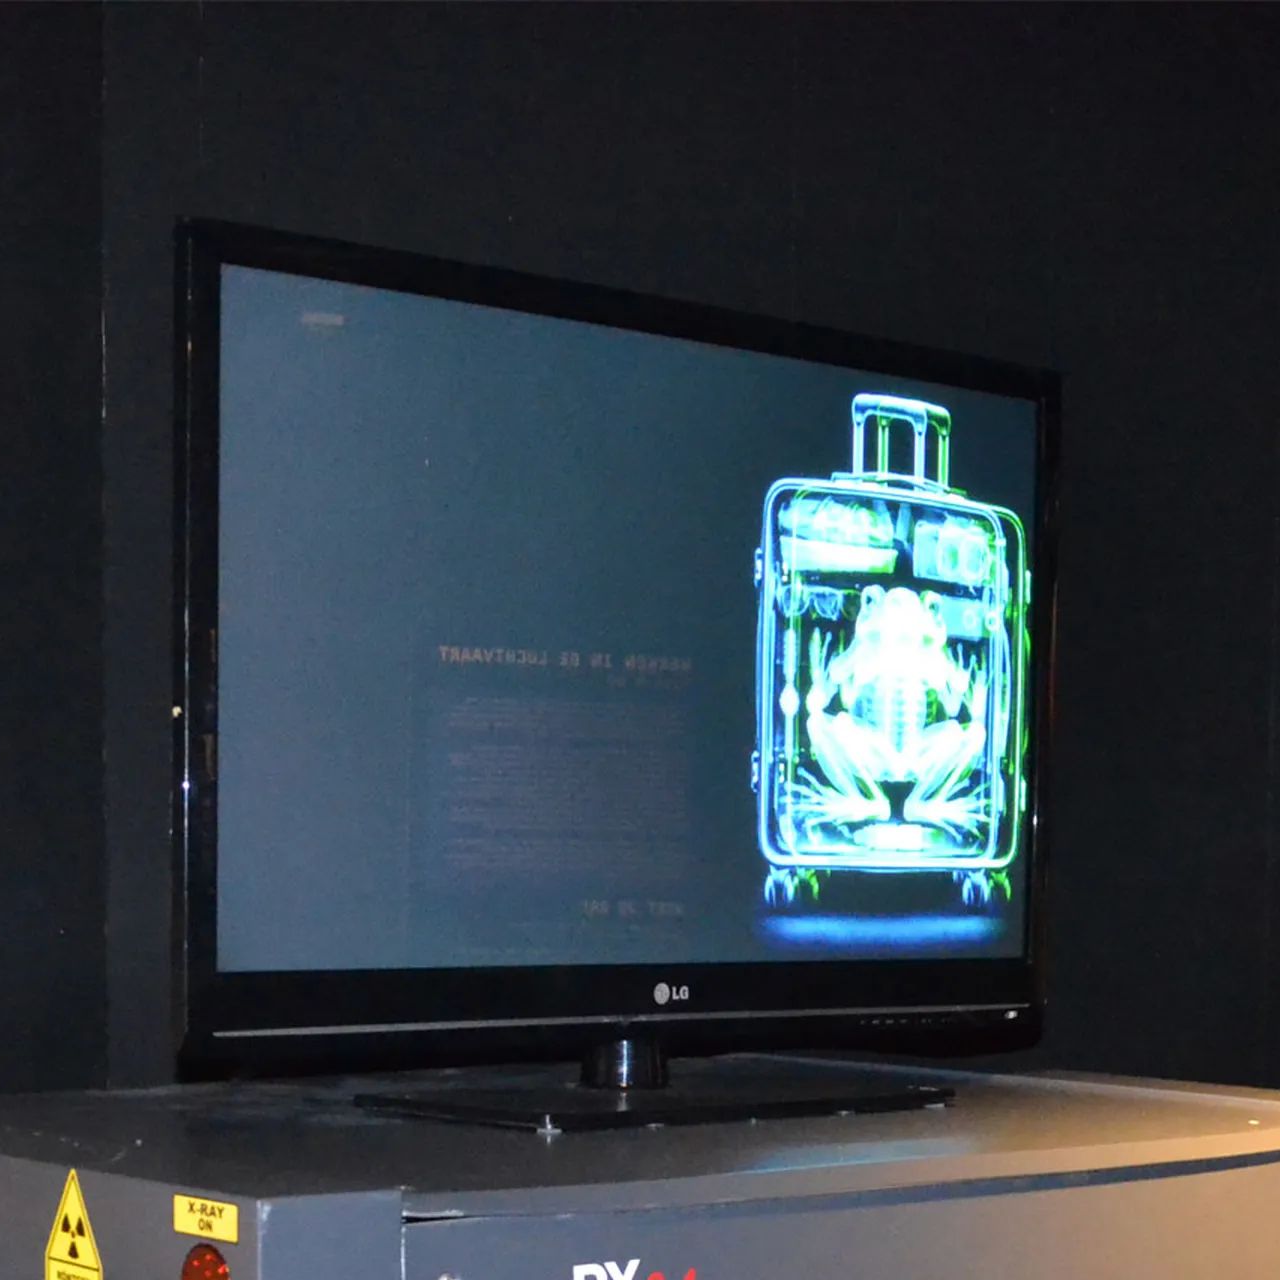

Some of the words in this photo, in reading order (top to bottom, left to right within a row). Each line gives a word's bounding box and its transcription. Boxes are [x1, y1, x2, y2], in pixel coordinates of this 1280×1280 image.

[672, 985, 689, 1000] LG
[188, 1201, 225, 1219] X-RAY
[198, 1219, 213, 1232] ON
